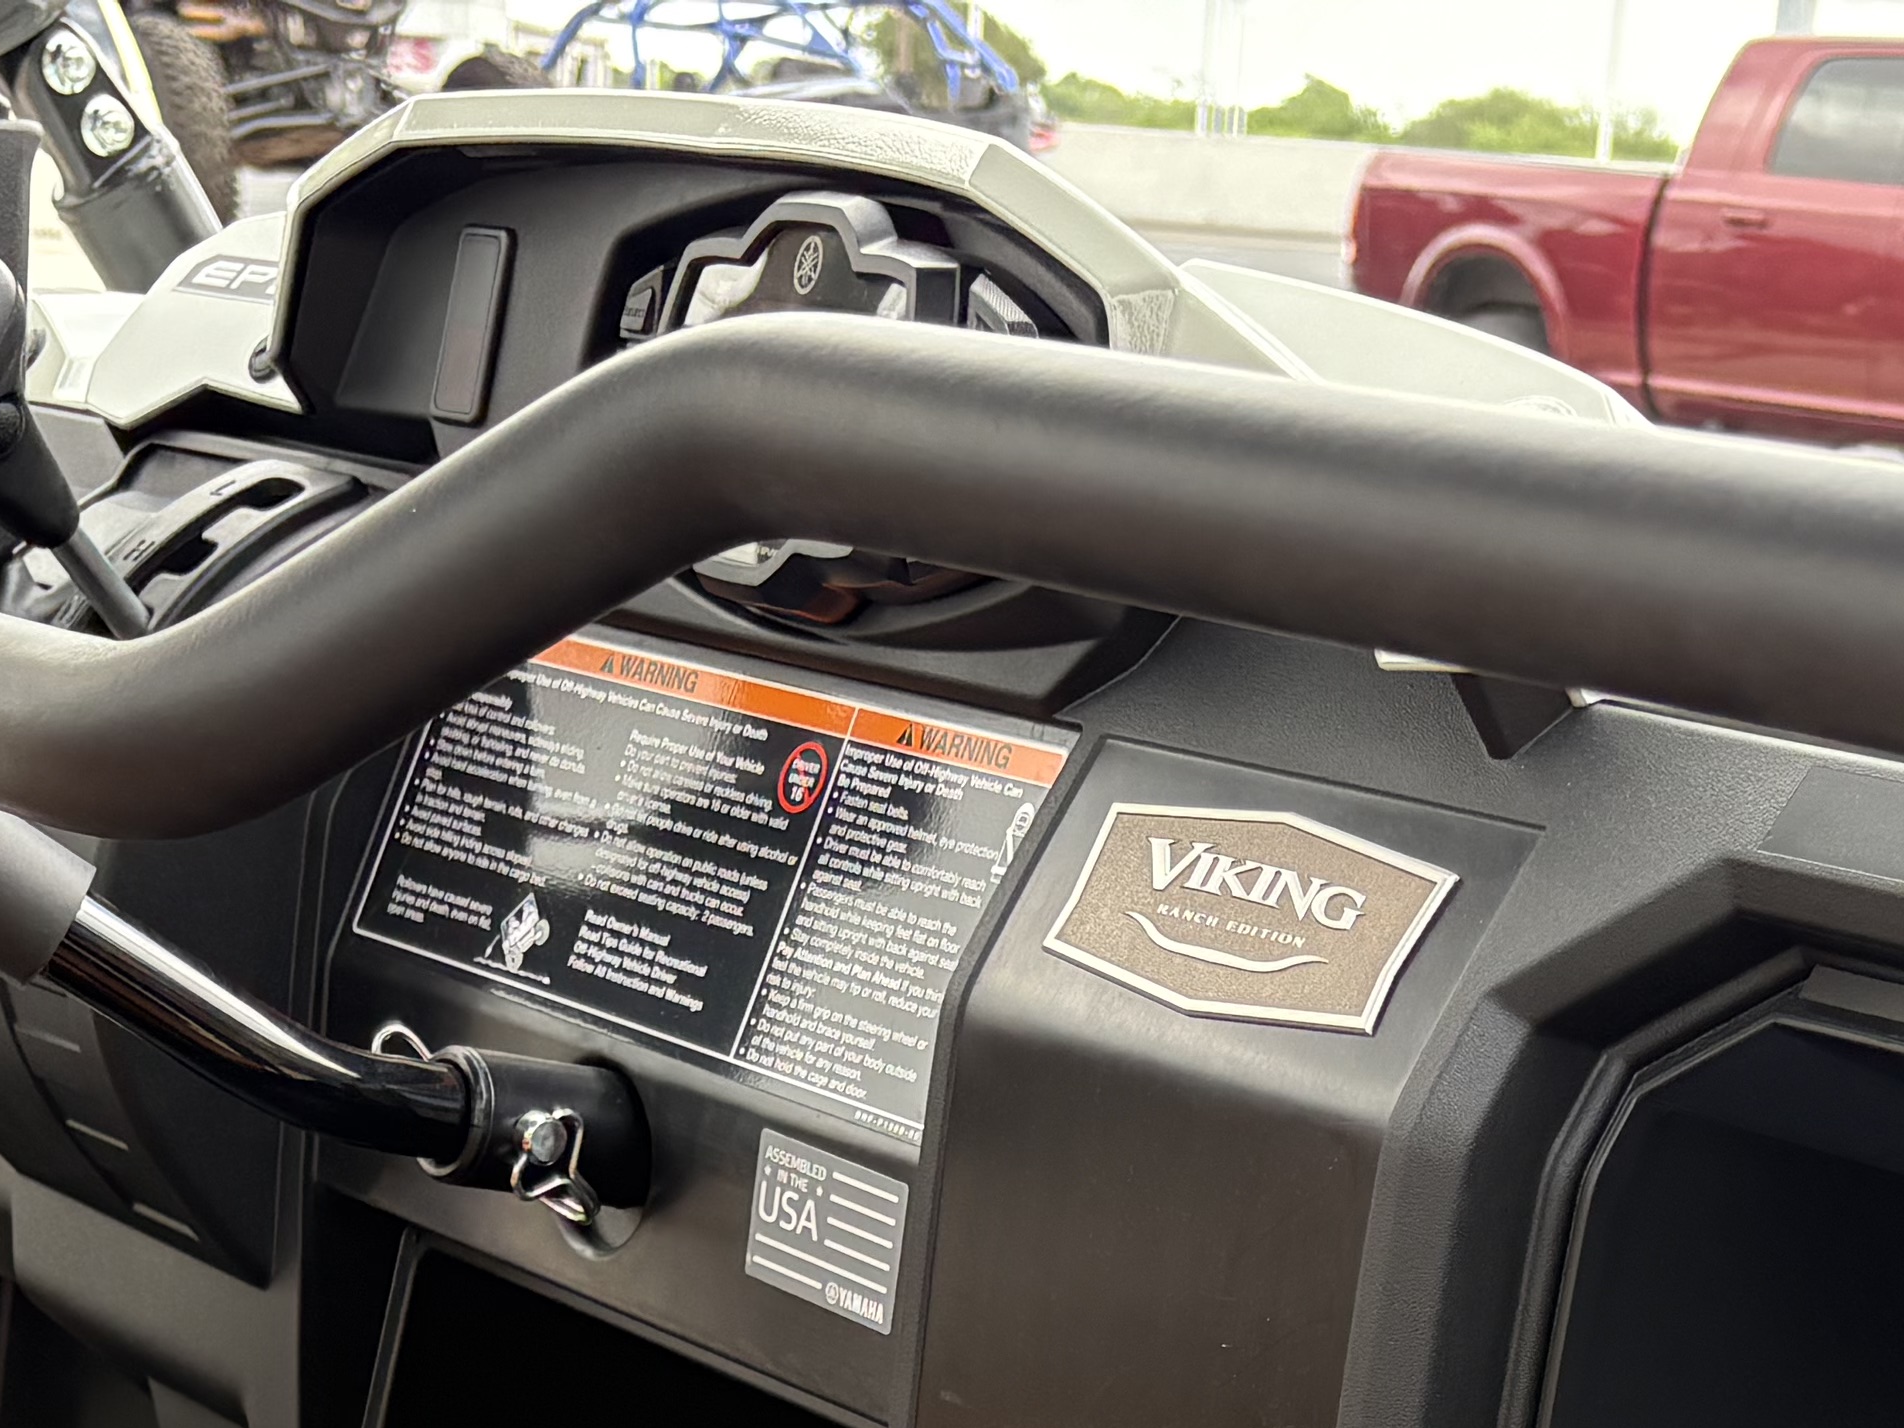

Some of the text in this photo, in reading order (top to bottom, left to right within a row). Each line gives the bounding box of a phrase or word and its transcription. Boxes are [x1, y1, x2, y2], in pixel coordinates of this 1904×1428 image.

[191, 259, 278, 296] EP
[619, 654, 699, 693] WARNING
[919, 725, 1014, 770] WARNING
[1147, 836, 1367, 930] VIKING
[1156, 903, 1306, 949] RANCH EDITION
[764, 1144, 828, 1181] ASSEMBLED
[776, 1168, 809, 1193] IN THE
[758, 1180, 819, 1242] USA
[838, 1286, 885, 1325] YAMAHA
